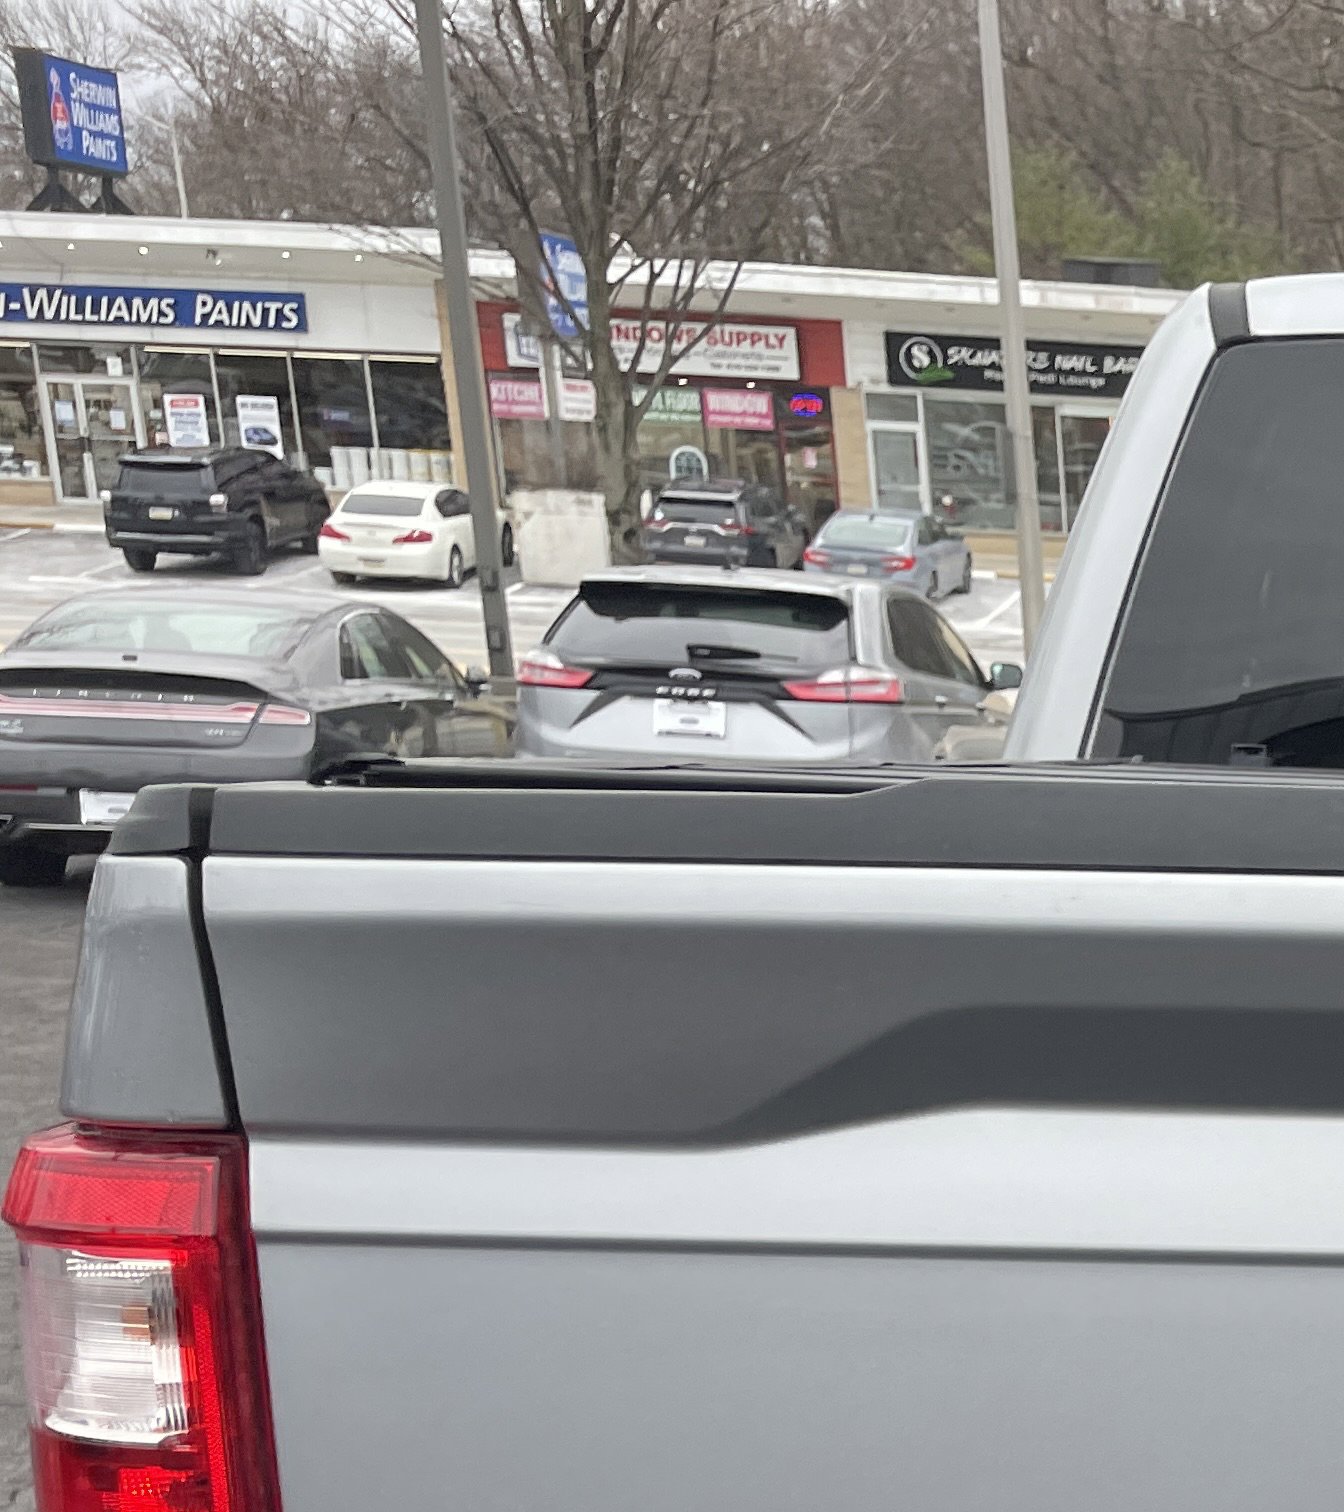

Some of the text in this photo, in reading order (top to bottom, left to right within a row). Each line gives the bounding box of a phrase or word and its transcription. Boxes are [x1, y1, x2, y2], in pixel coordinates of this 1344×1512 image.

[69, 71, 117, 109] SHERWIN
[70, 100, 120, 137] WILLIAMS
[82, 129, 117, 162] PAINTS
[193, 292, 299, 329] PAINTS
[706, 331, 787, 350] SUPPLY
